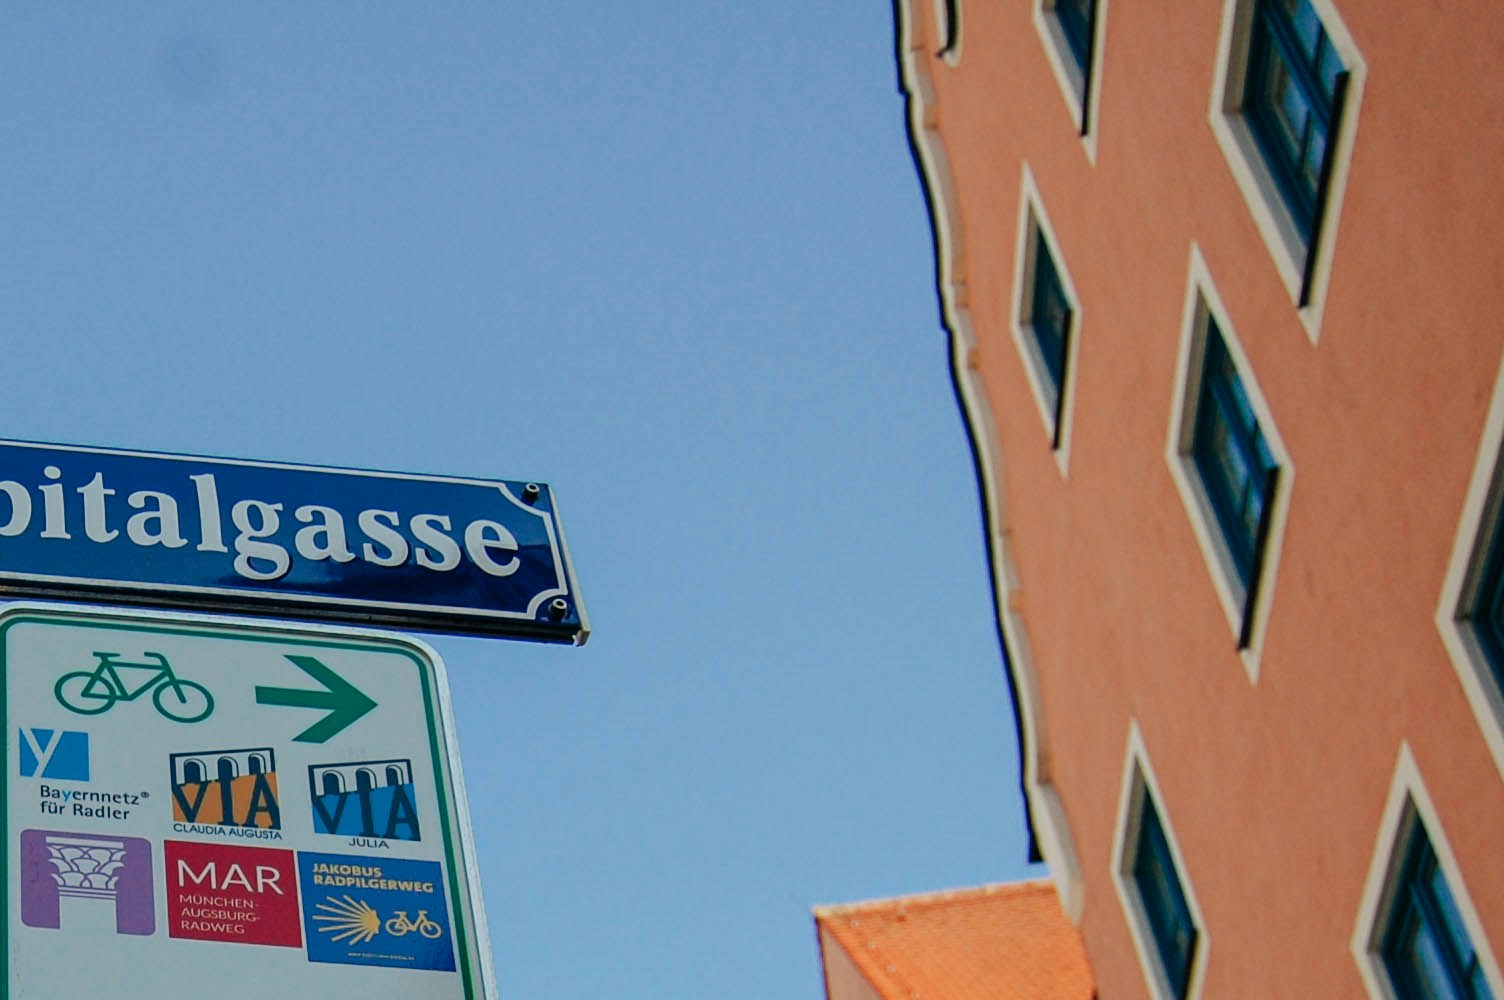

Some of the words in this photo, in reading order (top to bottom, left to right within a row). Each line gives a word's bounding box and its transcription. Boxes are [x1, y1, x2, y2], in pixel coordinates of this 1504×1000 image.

[171, 757, 282, 830] VIA
[40, 800, 66, 815] für
[72, 802, 131, 820] Radler
[309, 768, 422, 842] VIA
[173, 823, 227, 836] CLAUDIA
[228, 827, 283, 840] AUGUSTA
[348, 837, 390, 849] JULIA
[177, 859, 284, 895] MAR
[312, 863, 382, 878] JAKOBUS
[313, 874, 434, 893] RADPILGERWEG
[181, 920, 245, 934] RADWEG
